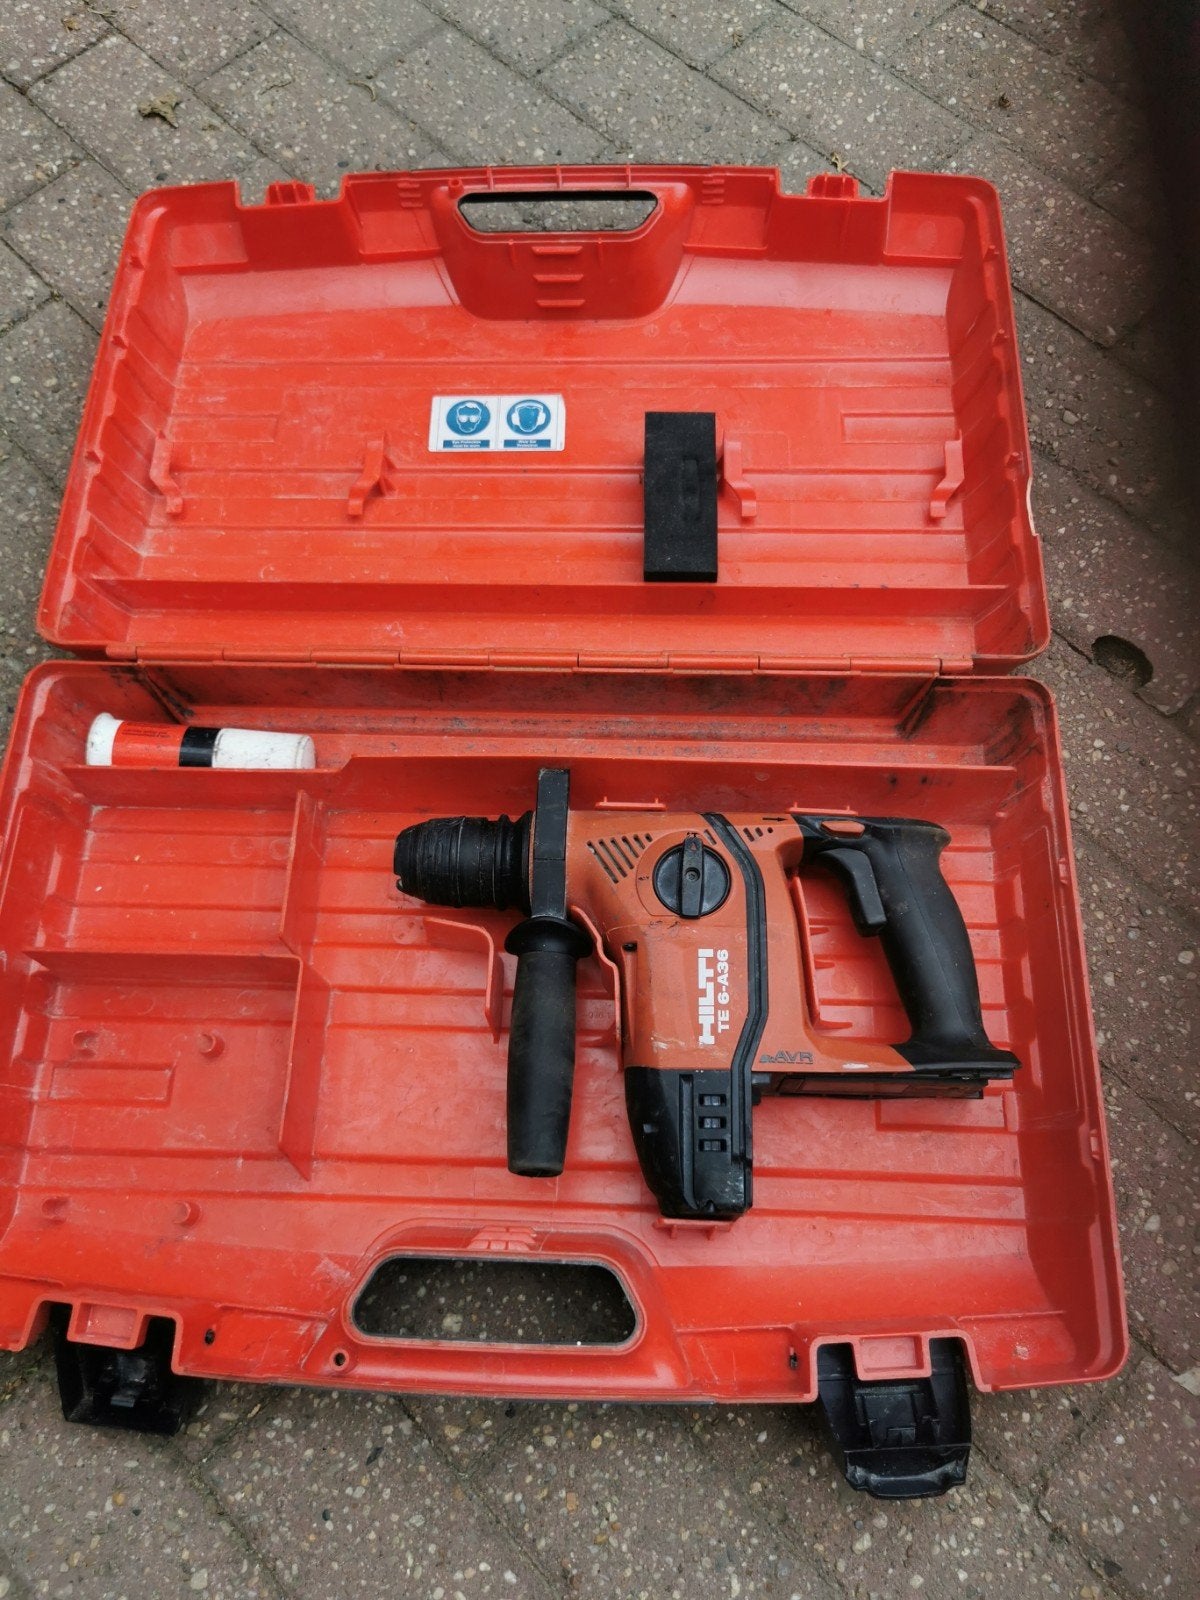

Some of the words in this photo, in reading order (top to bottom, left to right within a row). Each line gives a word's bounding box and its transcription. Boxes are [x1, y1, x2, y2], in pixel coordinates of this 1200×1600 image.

[697, 949, 715, 1045] HILTI
[716, 949, 730, 1005] 6-A36
[717, 1009, 730, 1033] TE
[775, 1050, 813, 1062] AVR
